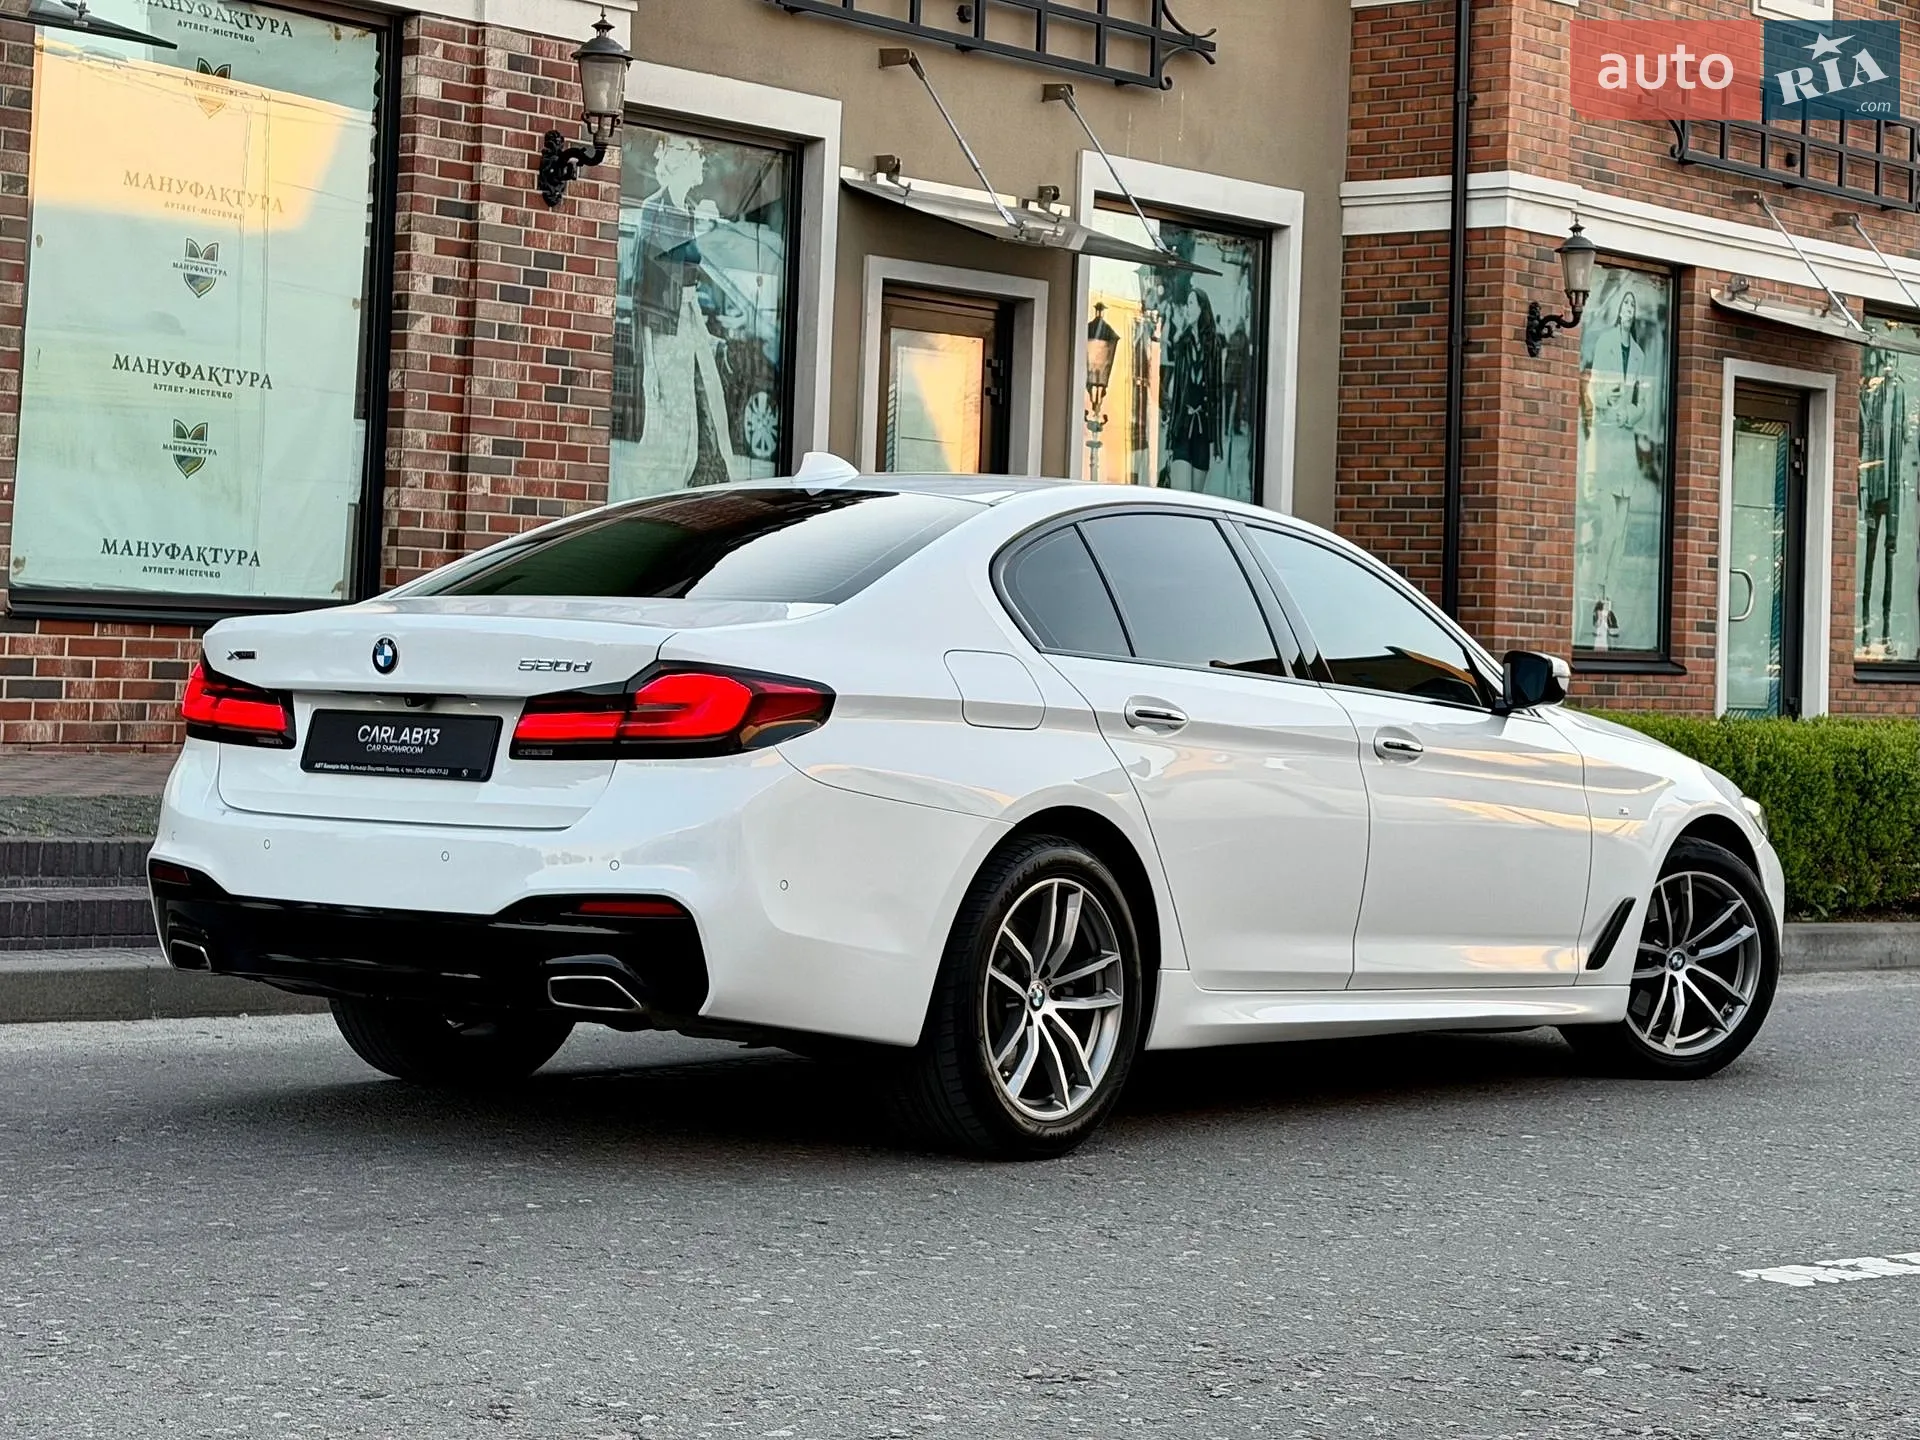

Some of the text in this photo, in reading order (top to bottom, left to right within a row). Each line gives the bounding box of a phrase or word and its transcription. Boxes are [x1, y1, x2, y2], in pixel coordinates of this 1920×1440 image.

[138, 0, 293, 37] АНУФАКТУРА
[123, 170, 284, 213] МАНУФАКТУРА
[112, 353, 273, 390] МАНУФАКТУРА
[101, 538, 261, 567] МАНУФАКТУРА
[518, 658, 592, 673] 520d
[357, 725, 441, 746] CARLAB13
[366, 744, 424, 755] CAR SHOWROOM
